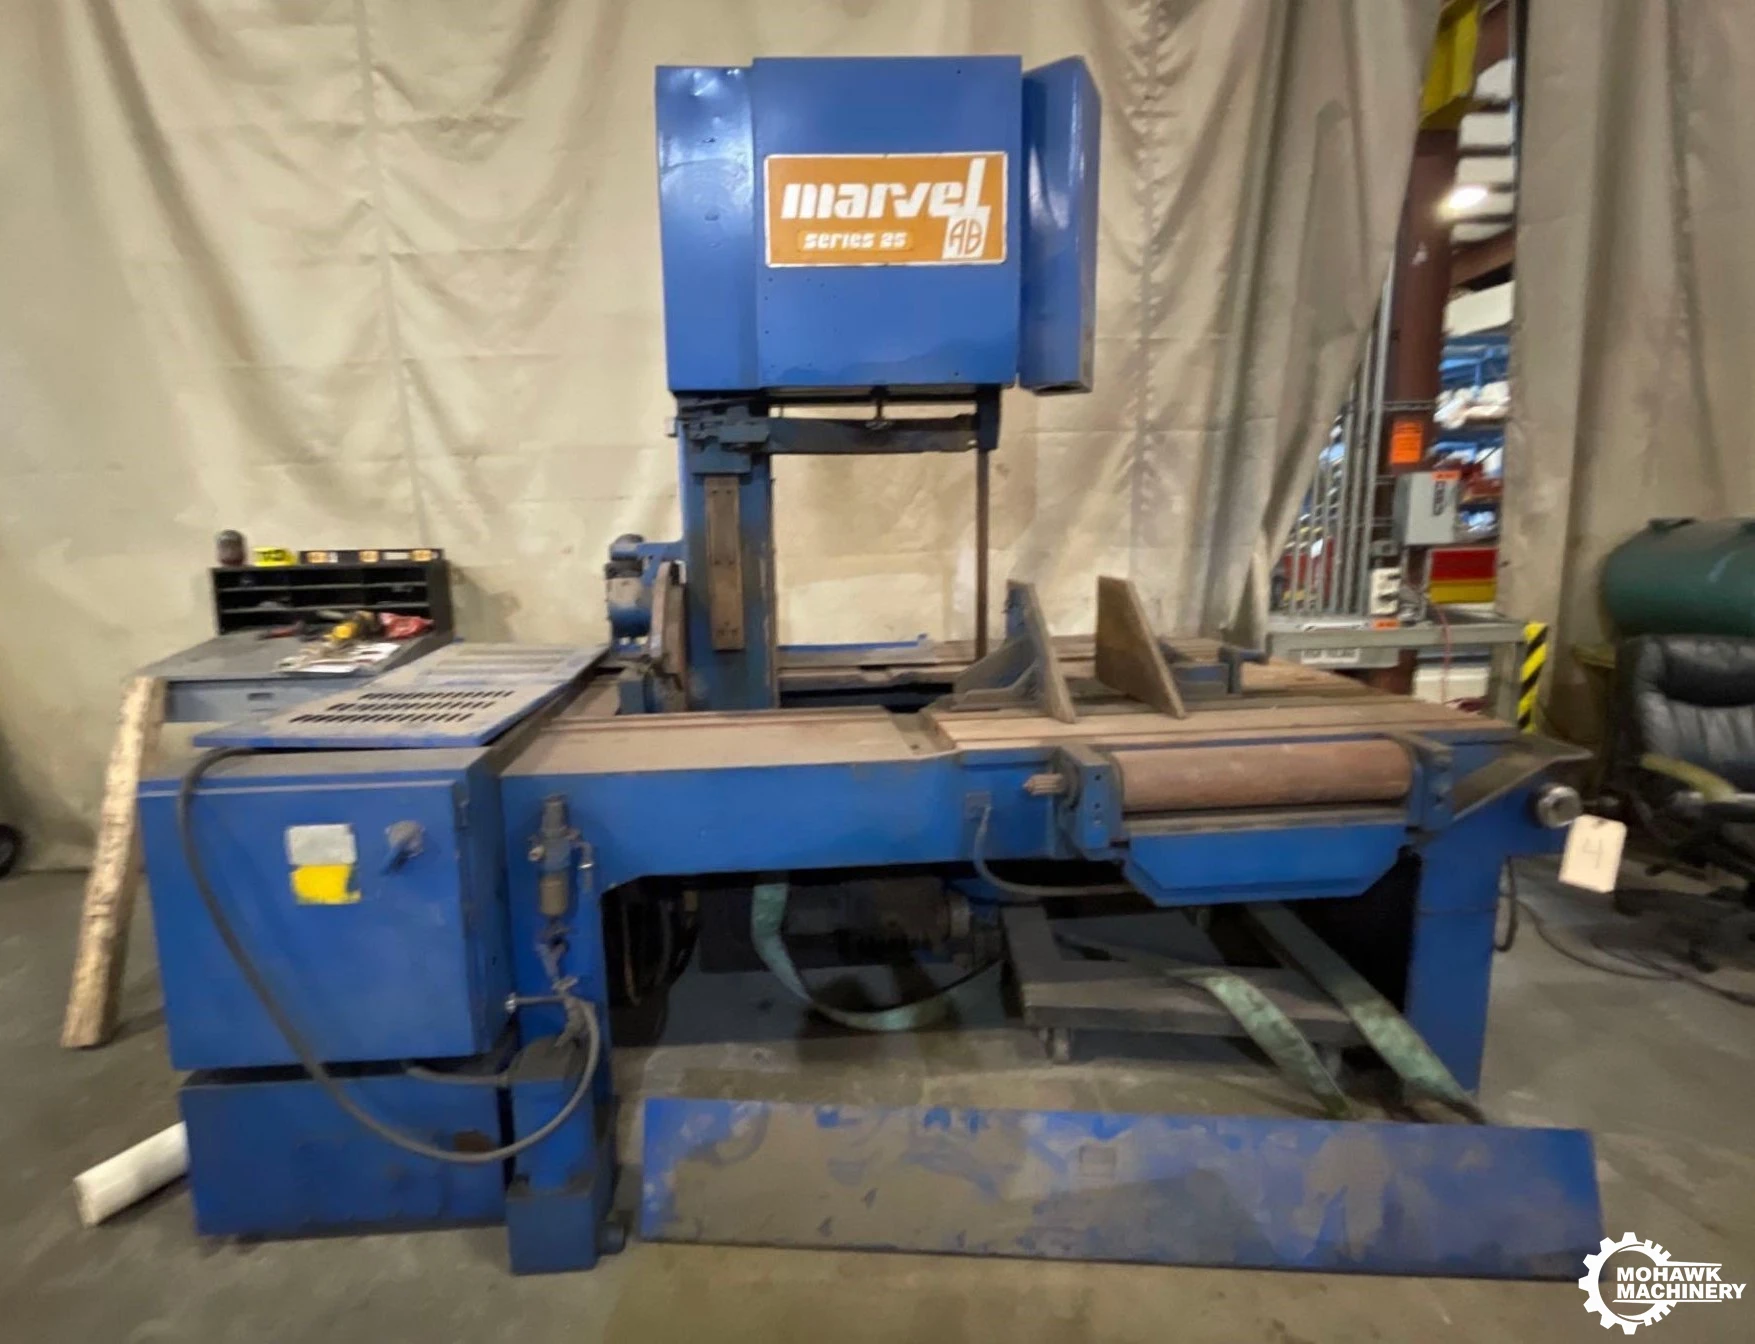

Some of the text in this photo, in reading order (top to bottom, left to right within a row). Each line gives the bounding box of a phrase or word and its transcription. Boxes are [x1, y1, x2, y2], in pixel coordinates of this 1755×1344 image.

[780, 158, 988, 219] marvel
[803, 231, 908, 249] series 25
